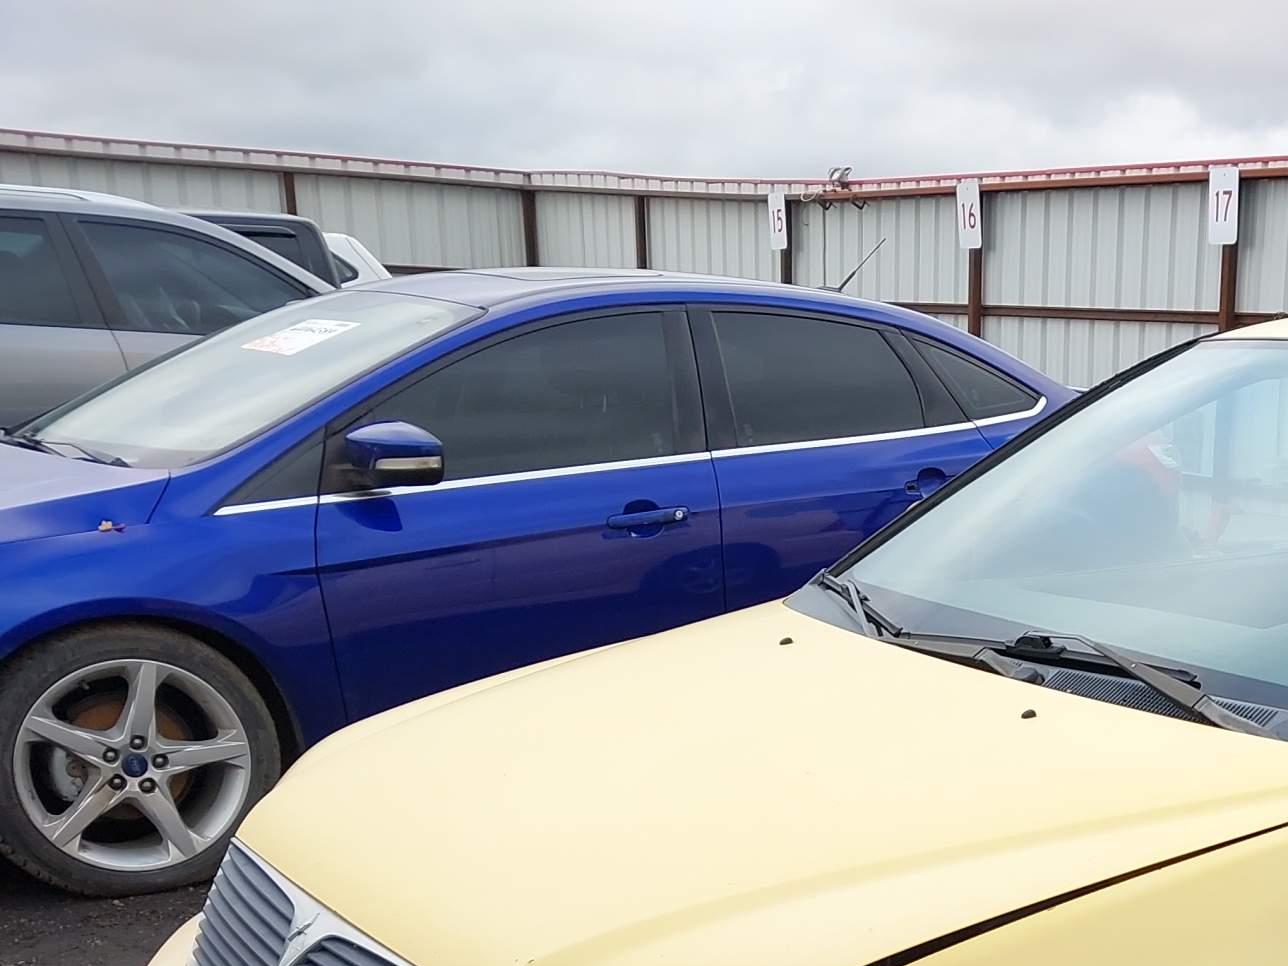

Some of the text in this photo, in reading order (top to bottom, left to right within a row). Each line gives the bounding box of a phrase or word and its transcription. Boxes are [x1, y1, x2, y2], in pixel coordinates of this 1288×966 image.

[771, 208, 784, 233] 15
[961, 202, 977, 230] 16
[1215, 190, 1233, 223] 17
